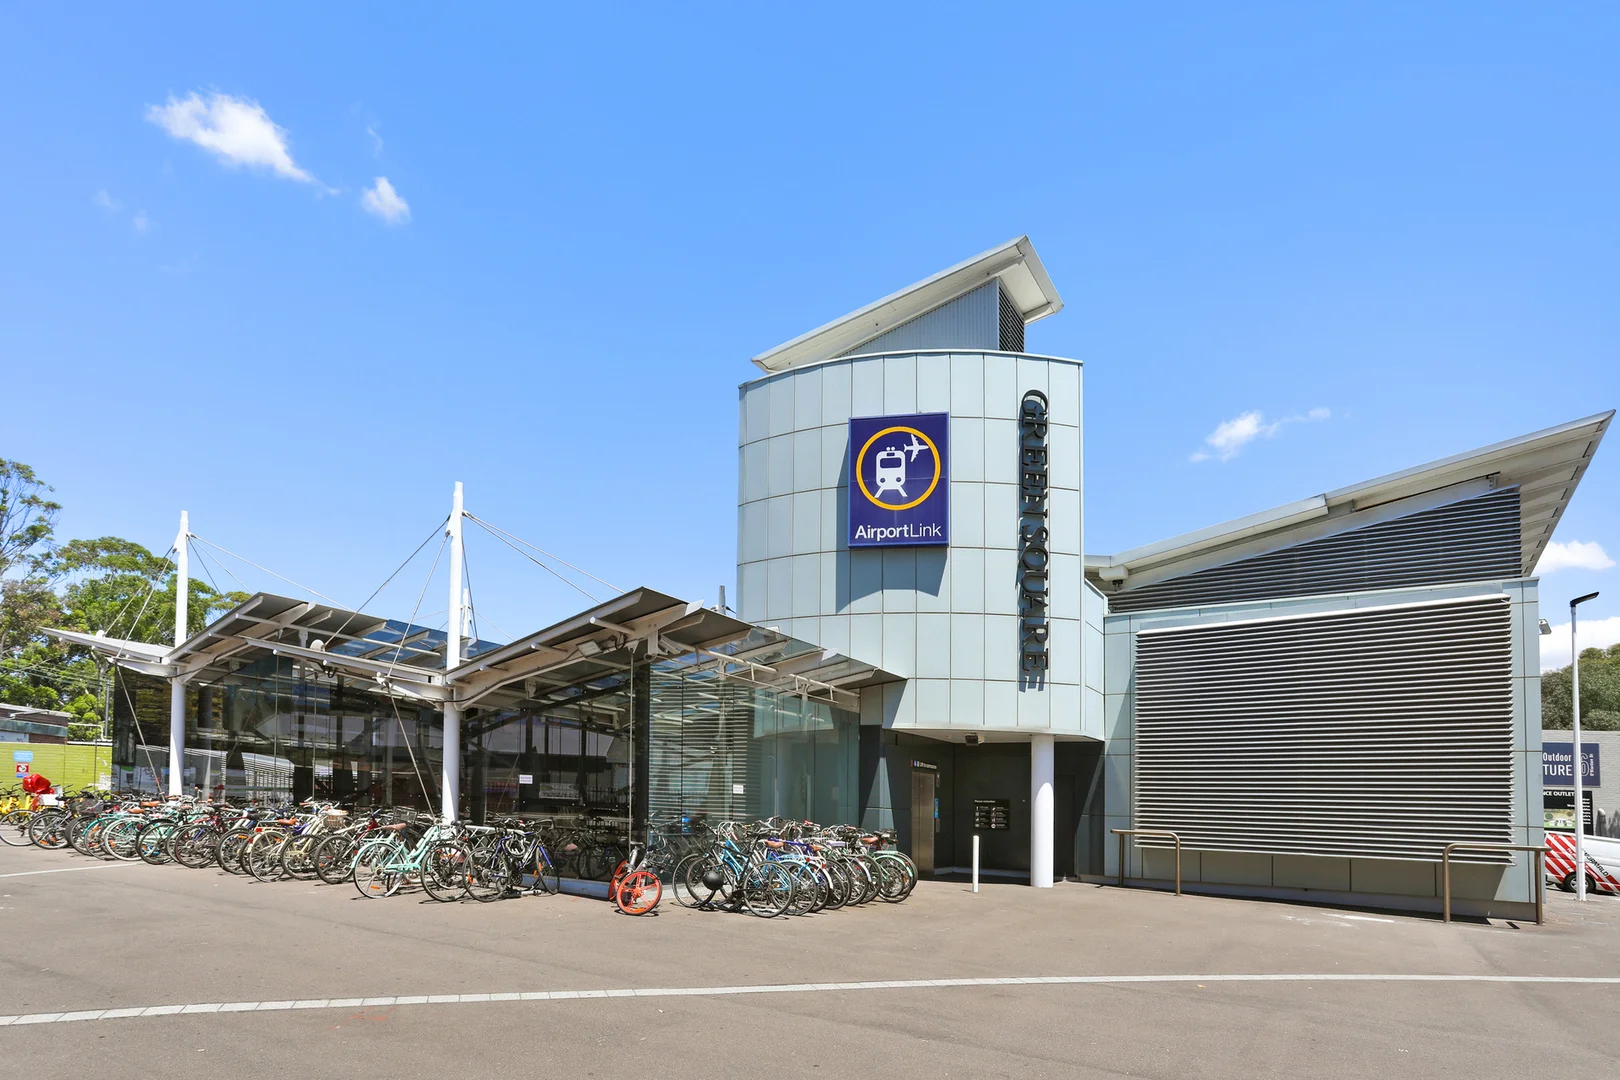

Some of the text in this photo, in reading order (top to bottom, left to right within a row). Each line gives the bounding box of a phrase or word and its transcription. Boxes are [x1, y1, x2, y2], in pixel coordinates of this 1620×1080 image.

[855, 523, 942, 542] AirportLink
[1021, 389, 1048, 672] GREEN SQUARE
[1543, 752, 1571, 762] Outdoor
[1543, 764, 1573, 776] TURE
